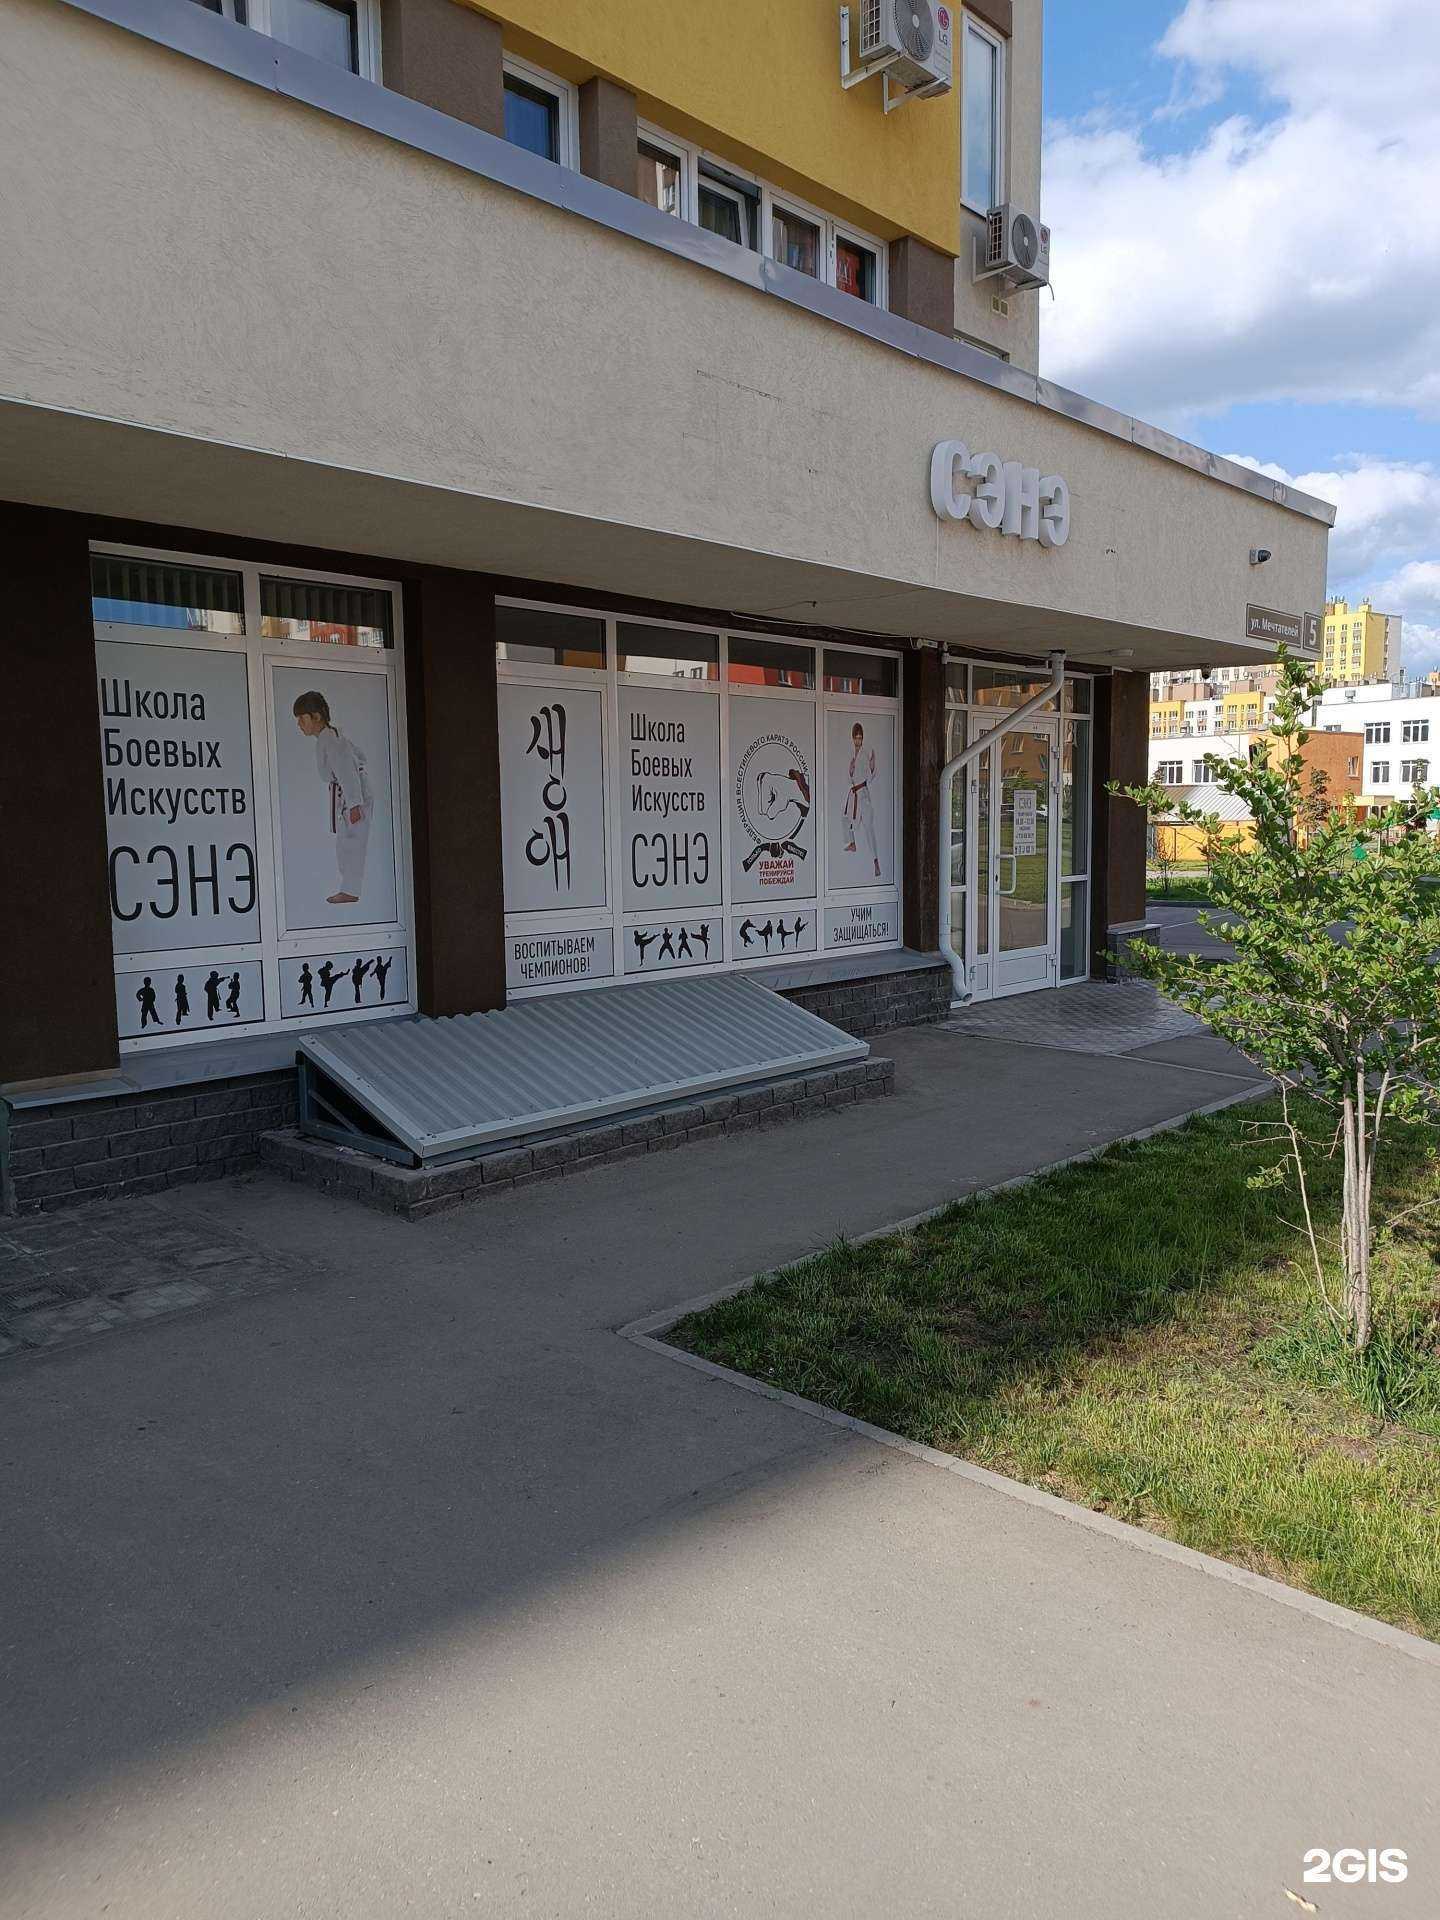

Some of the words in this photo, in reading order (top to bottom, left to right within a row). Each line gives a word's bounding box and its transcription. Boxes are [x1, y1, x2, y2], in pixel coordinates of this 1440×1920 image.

[938, 30, 947, 46] LG
[930, 439, 1070, 547] СЭНЭ
[1250, 617, 1261, 631] ул.
[1262, 617, 1299, 637] Мечтателей
[1309, 619, 1317, 646] 5
[101, 678, 206, 720] Школа
[630, 713, 685, 743] Школа
[766, 734, 789, 745] КАРАТЭ
[104, 728, 222, 768] Боевых
[631, 749, 692, 778] Боевых
[106, 778, 247, 824] Искусств
[632, 784, 705, 818] Искусств
[632, 832, 709, 888] СЭНЭ
[759, 858, 794, 870] УВАЖАЙ
[109, 843, 256, 921] СЭНЭ
[759, 876, 794, 886] ПОБЕЖДАЙ
[850, 906, 872, 922] УЧИМ
[833, 922, 889, 942] ЗАЩИЩАТЬСЯ!
[514, 937, 595, 960] ВОСПИТЫВАЕМ
[520, 957, 591, 979] ЧЕМПИОНОВ!
